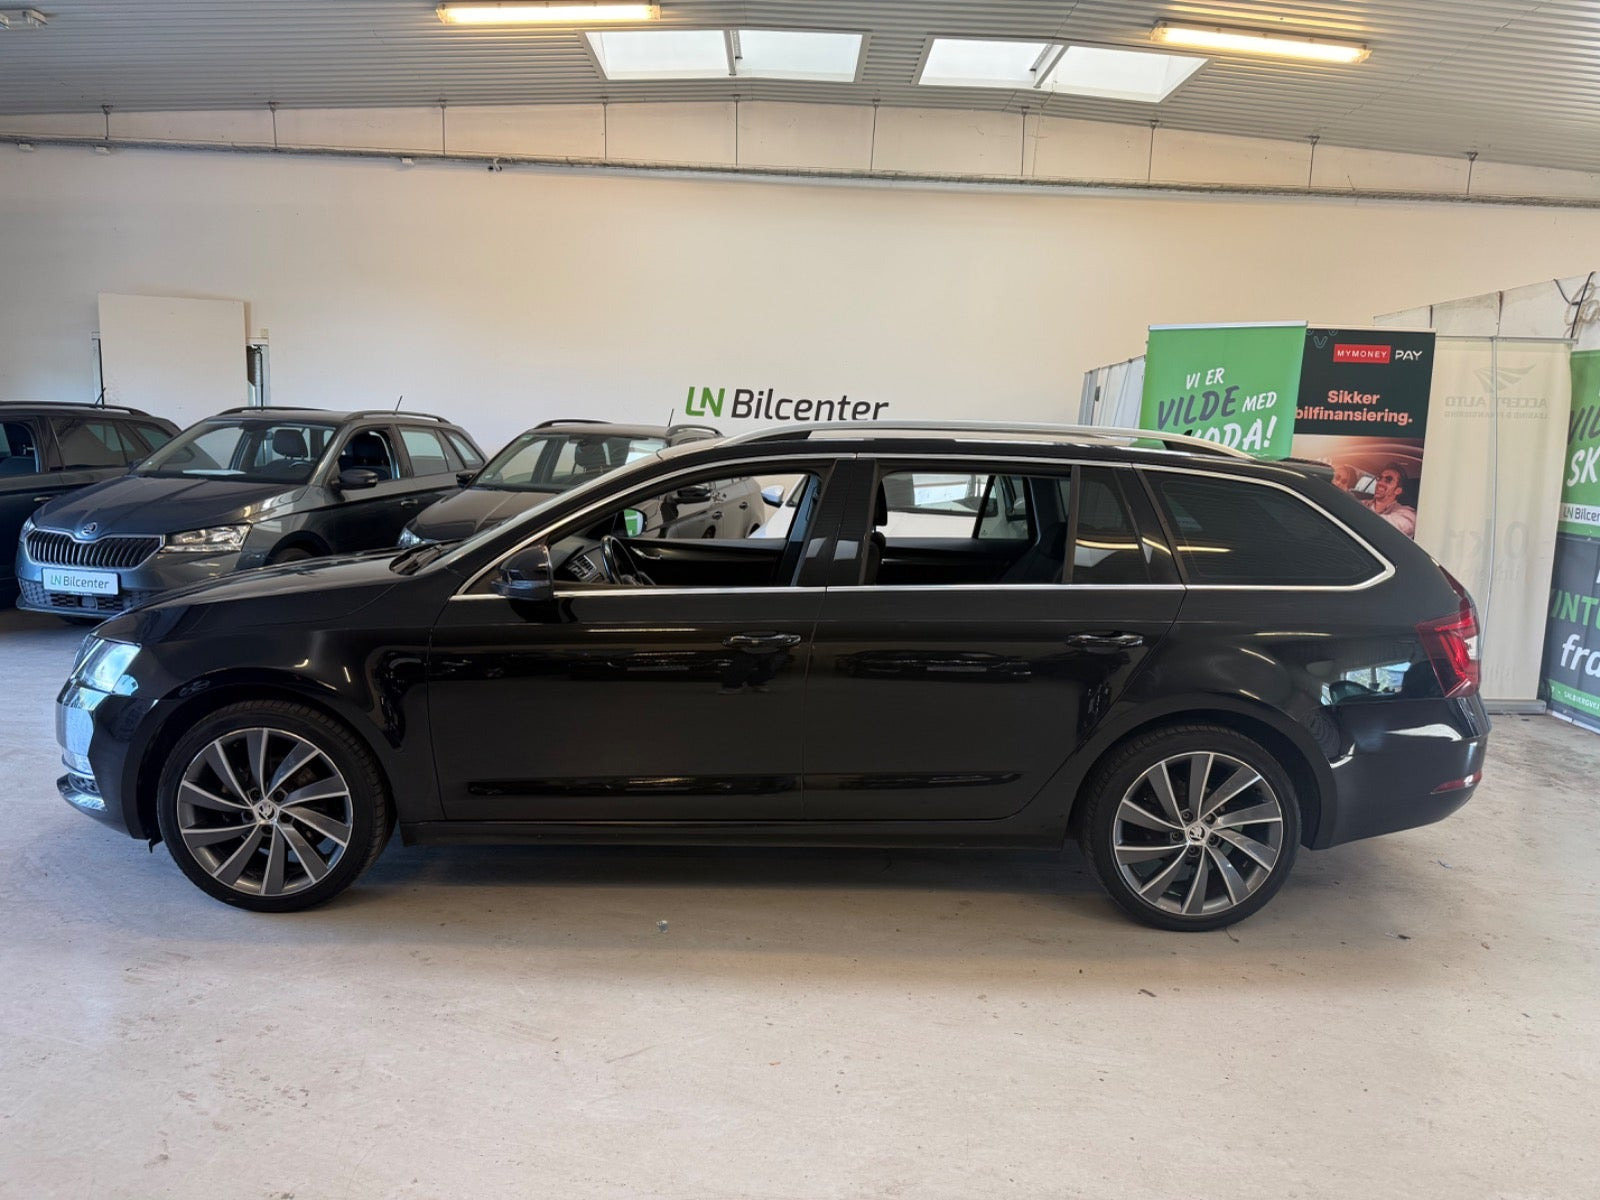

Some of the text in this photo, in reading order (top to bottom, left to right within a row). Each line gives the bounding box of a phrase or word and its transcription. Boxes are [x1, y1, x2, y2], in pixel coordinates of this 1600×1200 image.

[1337, 350, 1423, 360] MYMONEY PAY
[1186, 367, 1225, 390] VI ER
[685, 386, 889, 421] LN Bilcenter
[1327, 390, 1380, 405] Sikker
[1157, 385, 1277, 431] VILDE MED
[1295, 406, 1413, 426] bilfinansiering.
[63, 575, 110, 589] Bilcenter
